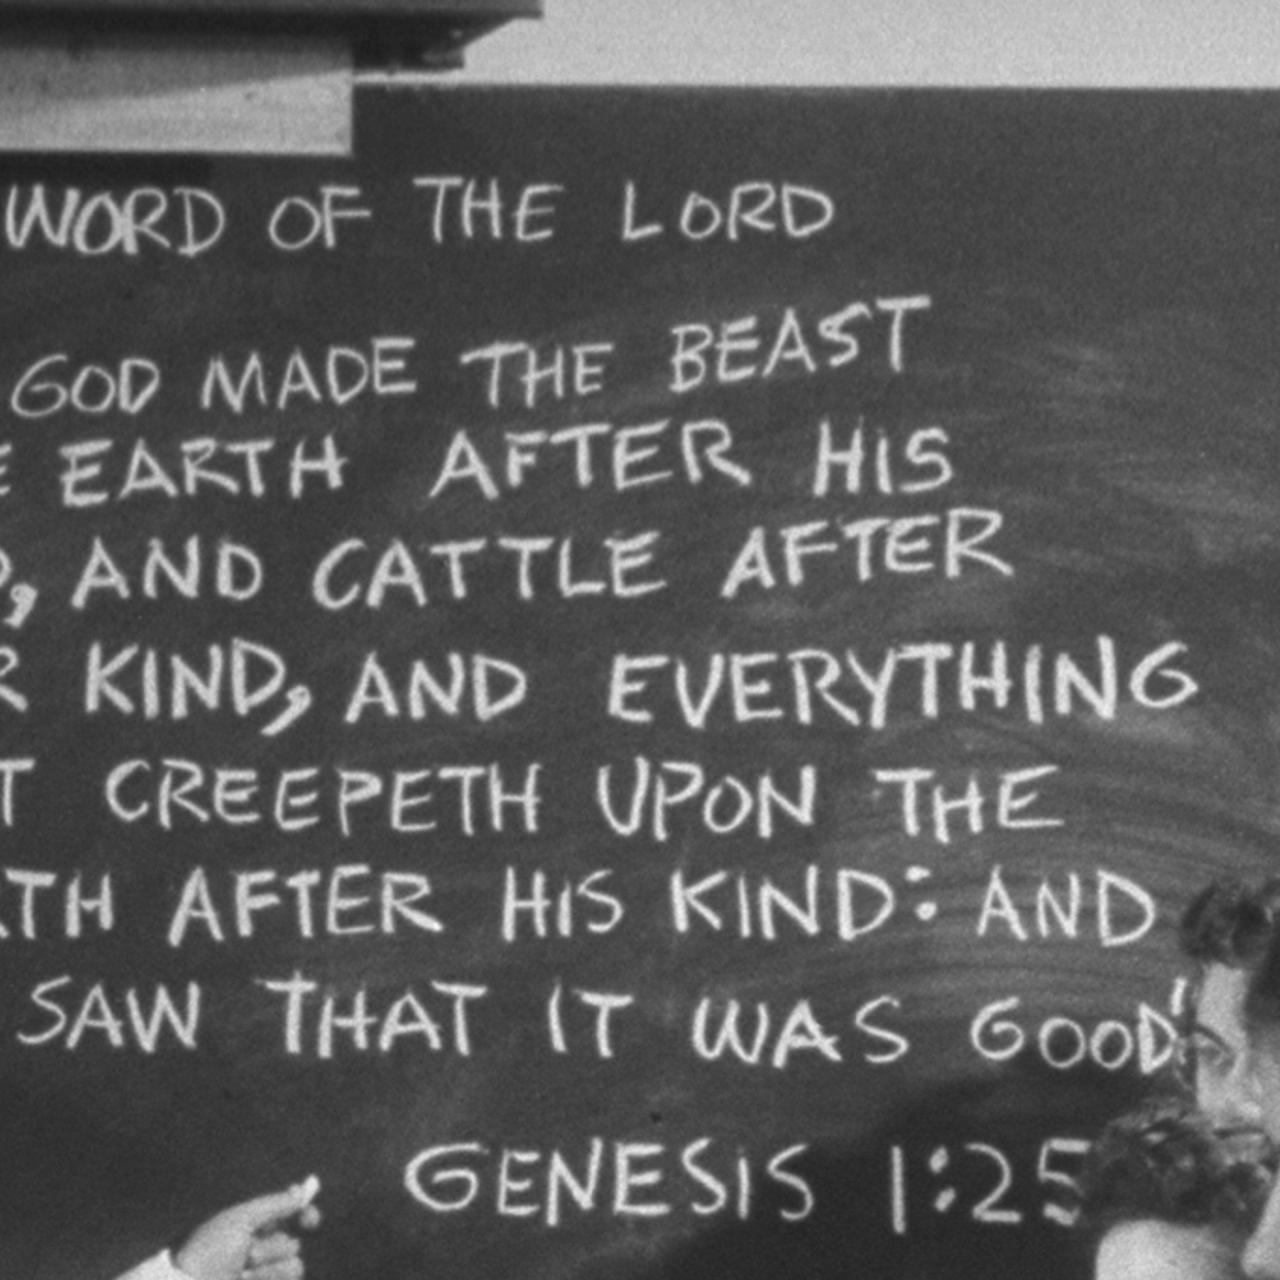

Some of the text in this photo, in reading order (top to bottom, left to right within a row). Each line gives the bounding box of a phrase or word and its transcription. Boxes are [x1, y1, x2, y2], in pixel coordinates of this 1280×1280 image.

[4, 184, 226, 258] WORD
[267, 183, 372, 251] OF
[413, 175, 563, 243] THE
[622, 181, 835, 241] LORD
[10, 353, 161, 418] GOD
[200, 336, 417, 414] MADE
[460, 341, 614, 408] THE
[669, 294, 931, 394] BEAST
[59, 434, 346, 508] EARTH
[429, 418, 752, 500] AFTER
[812, 421, 953, 497] HIS
[70, 535, 263, 610] AND
[312, 530, 667, 610] CATTLE
[721, 506, 1014, 598] AFTER
[85, 637, 313, 737] KIND,
[344, 652, 527, 724] AND
[608, 635, 1199, 730] EVERYTHING
[105, 758, 541, 836] CREEPETH
[596, 755, 817, 842] UPON
[874, 764, 1063, 845] THE
[168, 863, 444, 947] AFTER
[501, 866, 624, 943] HIS
[670, 864, 938, 942] KIND:
[976, 865, 1156, 947] AND
[17, 975, 201, 1054] SAW
[264, 971, 488, 1059] THAT
[547, 986, 634, 1059] IT
[691, 995, 909, 1069] WAS
[404, 1137, 1090, 1234] GENESIS 1:25
